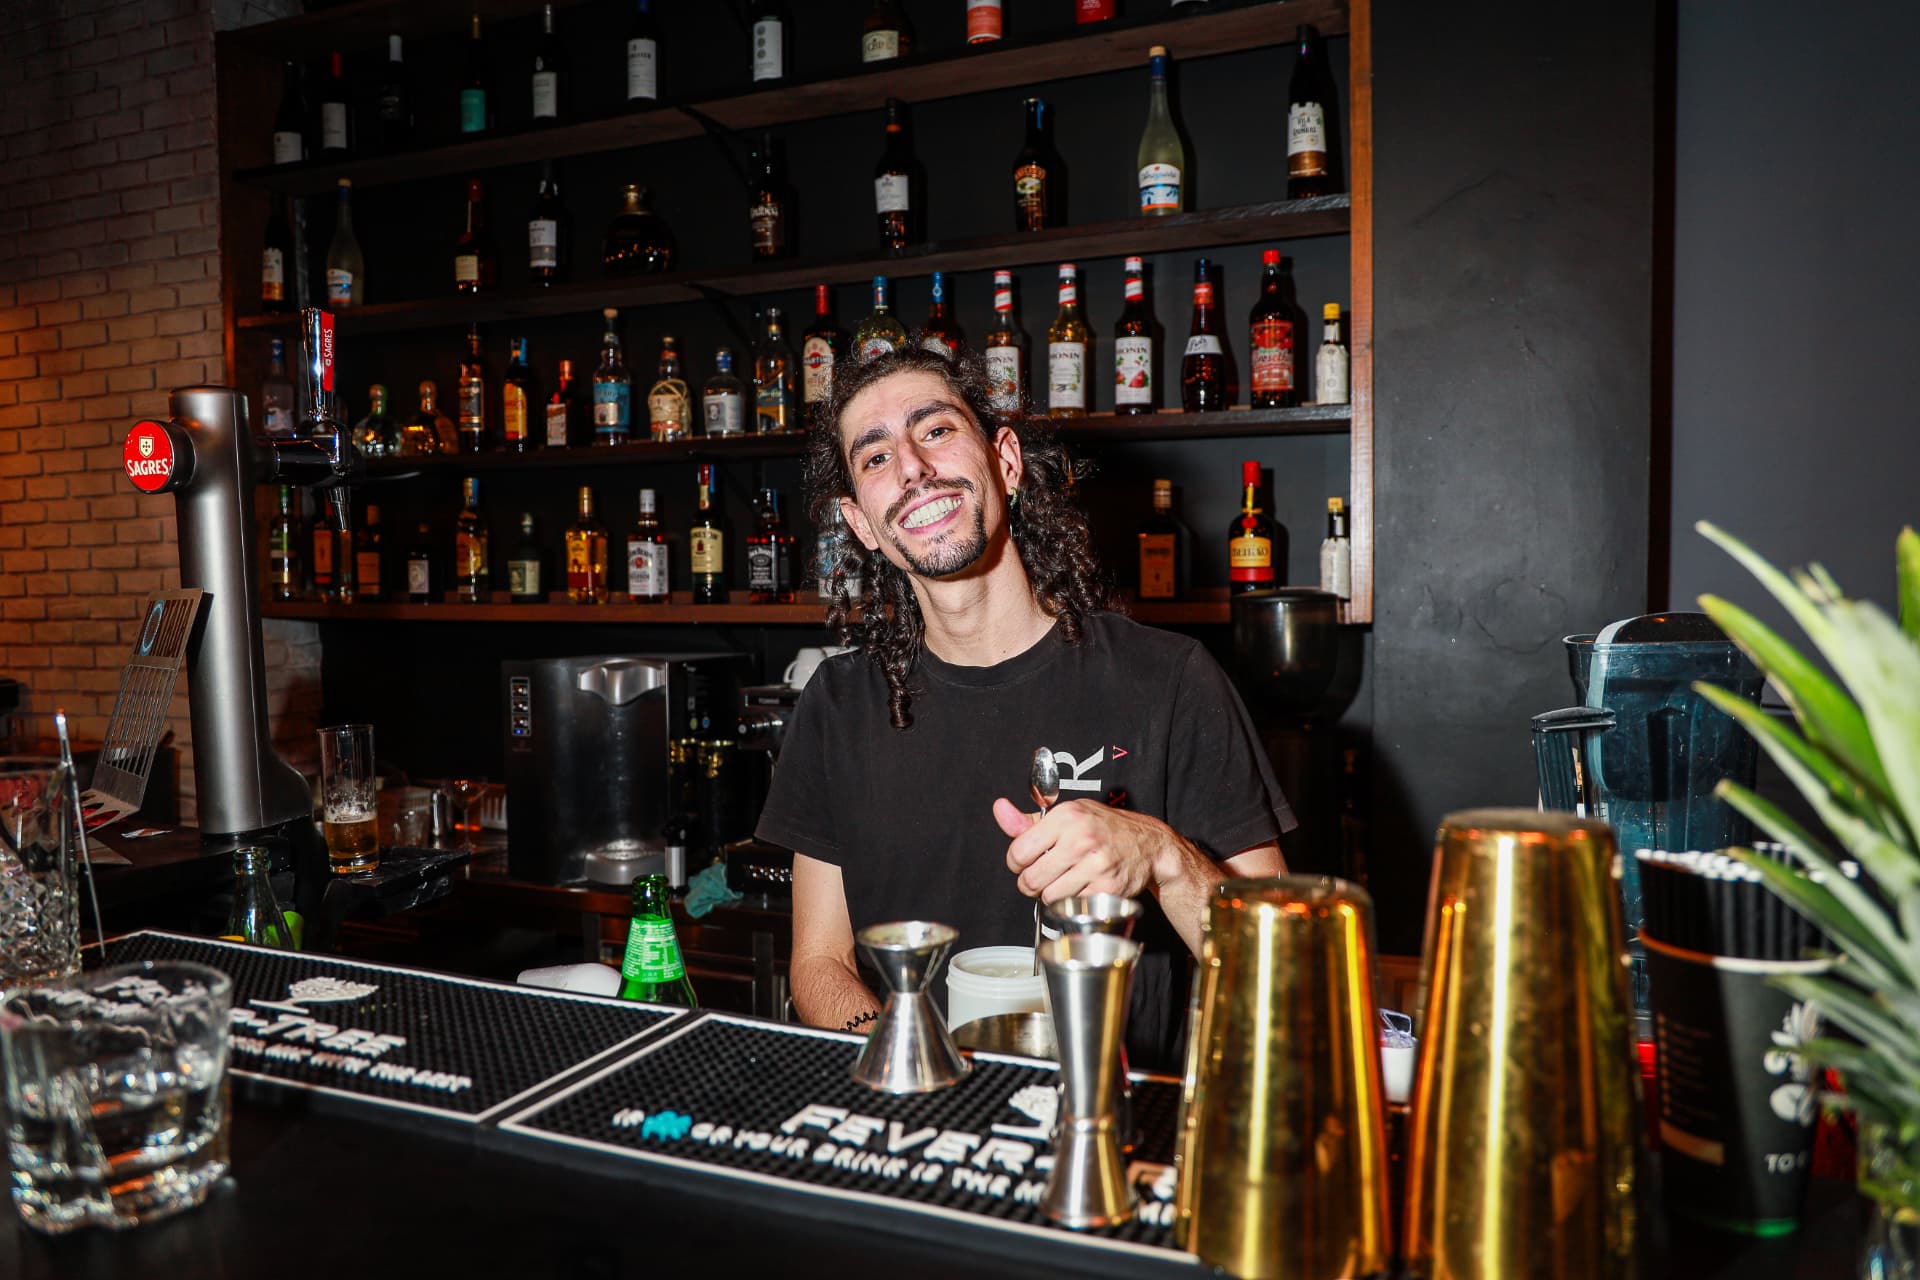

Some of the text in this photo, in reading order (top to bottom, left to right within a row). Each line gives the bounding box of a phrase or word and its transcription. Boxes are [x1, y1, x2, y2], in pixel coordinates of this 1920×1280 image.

[324, 328, 333, 359] SAGRES
[126, 457, 170, 478] SAGRES
[732, 1128, 810, 1160] YOUR
[812, 1142, 909, 1180] DRINK
[951, 1166, 1012, 1200] THE
[781, 1103, 1056, 1176] FEVER-
